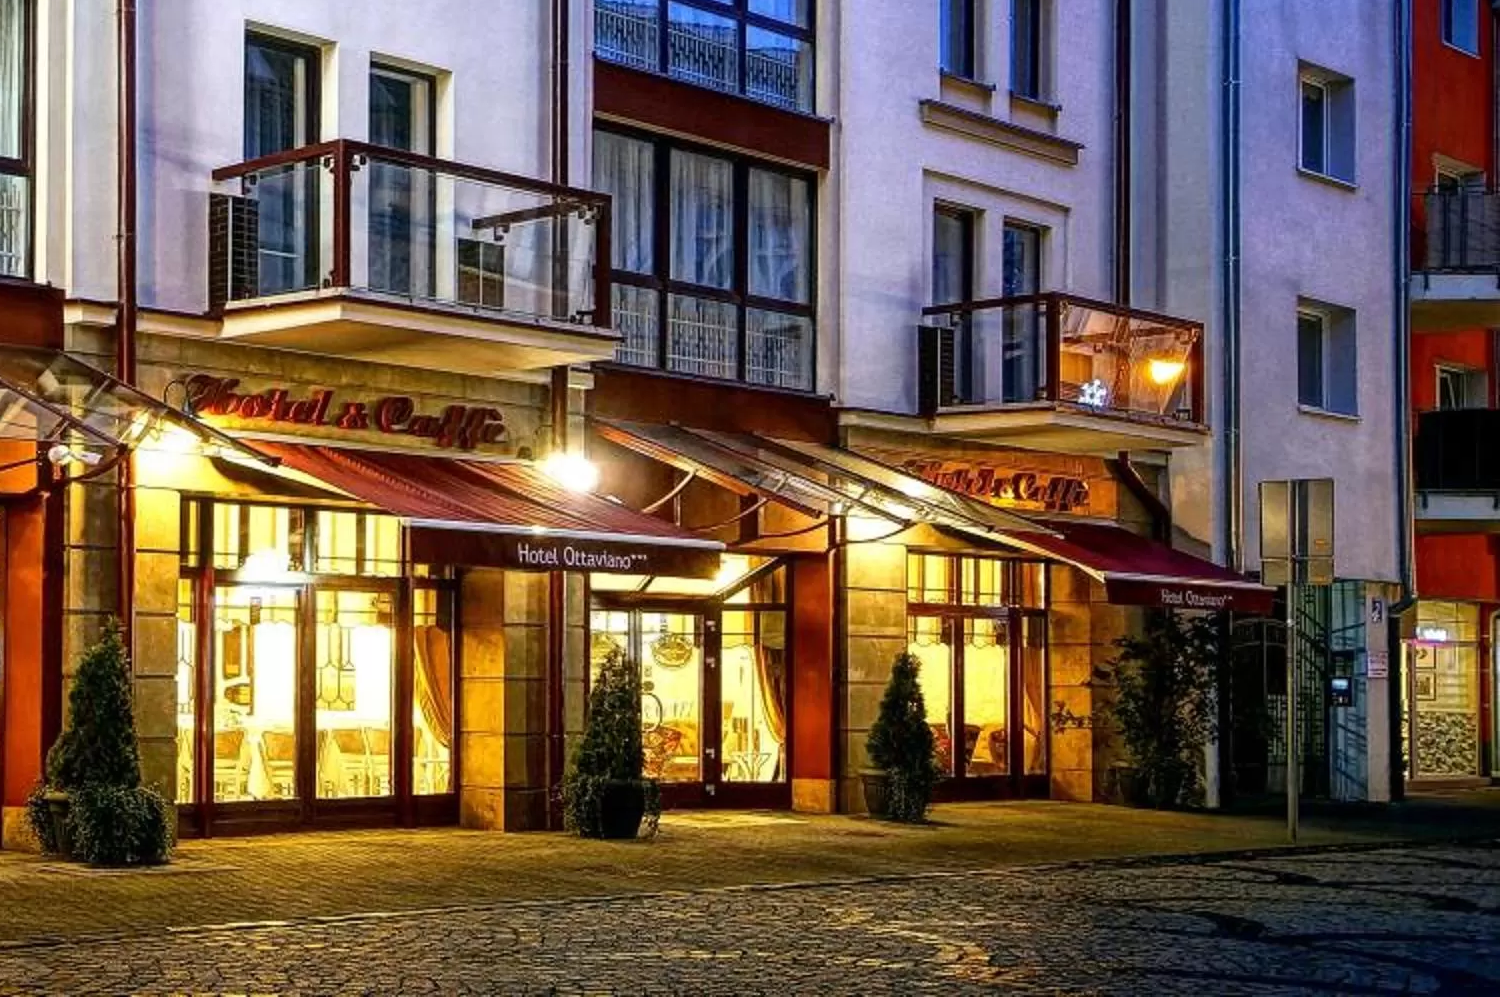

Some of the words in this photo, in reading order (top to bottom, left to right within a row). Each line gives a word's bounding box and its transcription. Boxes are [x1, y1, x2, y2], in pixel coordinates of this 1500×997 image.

[184, 374, 335, 427] Hotel
[338, 401, 369, 429] &
[517, 542, 559, 566] Hotel
[563, 546, 632, 570] Ottaviano
